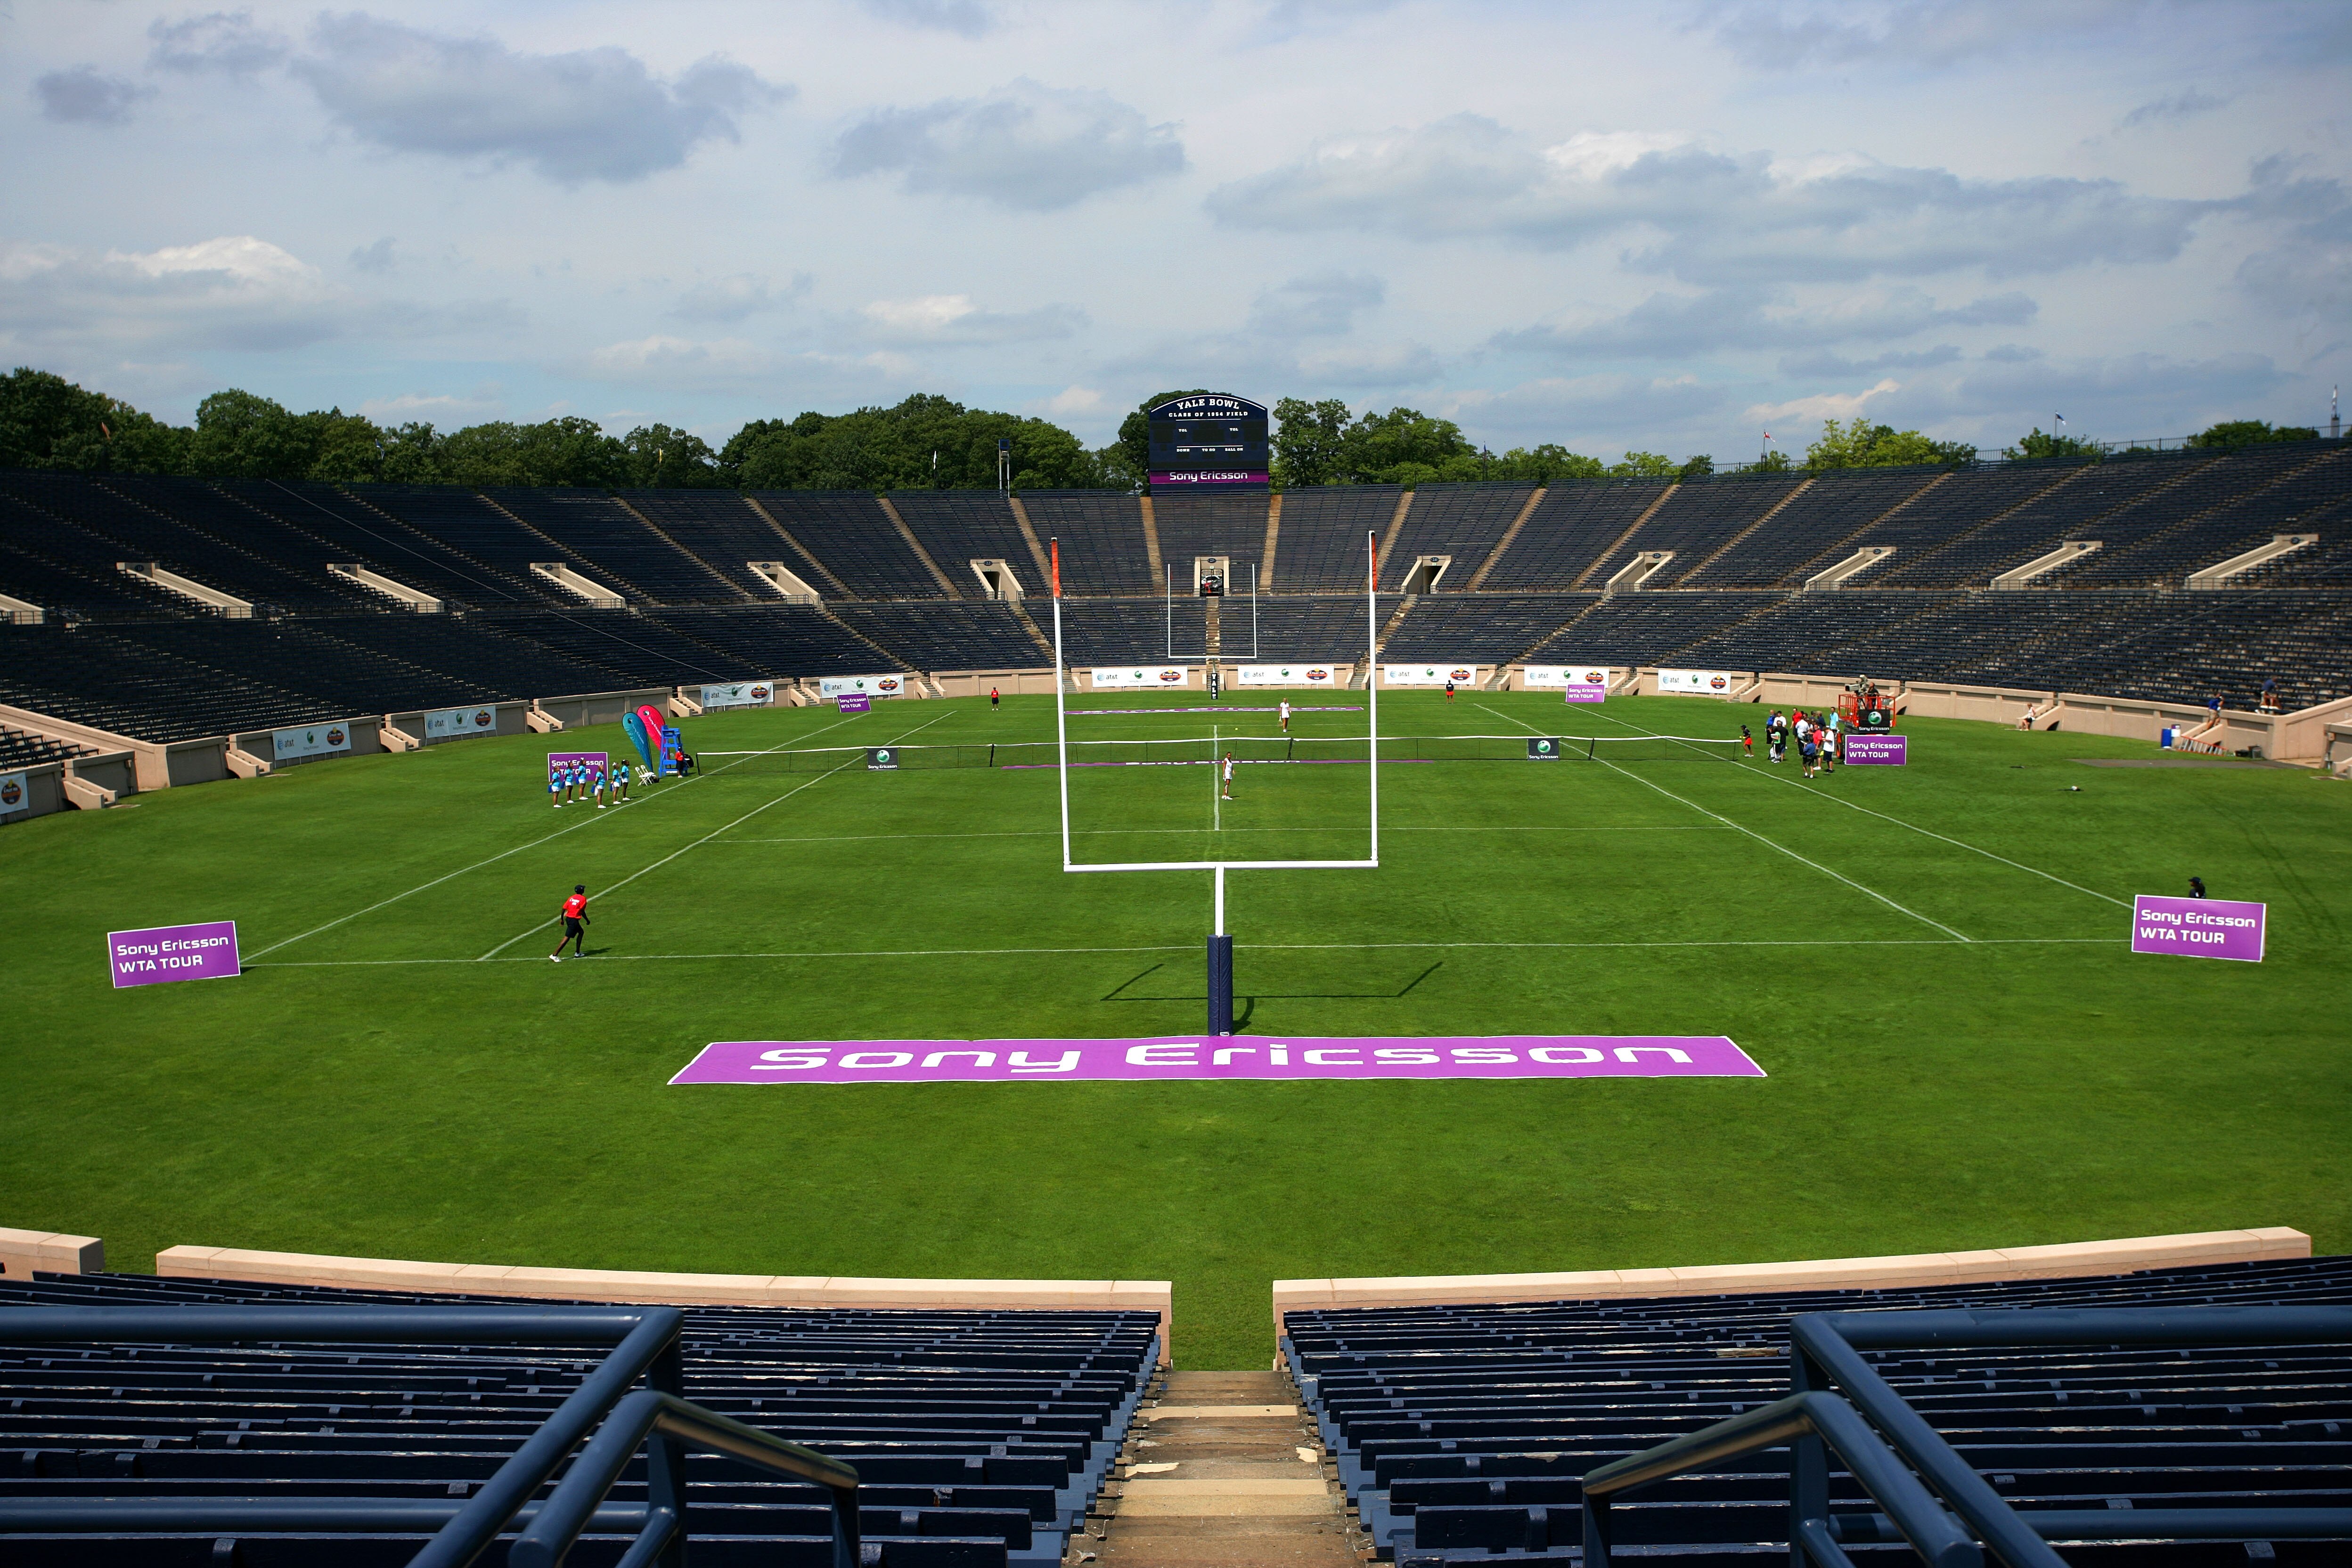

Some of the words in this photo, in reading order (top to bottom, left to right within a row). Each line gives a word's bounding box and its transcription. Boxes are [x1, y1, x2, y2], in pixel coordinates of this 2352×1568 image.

[1176, 399, 1205, 410] YALE
[1209, 399, 1239, 409] BOWL
[1169, 472, 1197, 482] Sony
[1200, 472, 1248, 480] Ericsson
[284, 738, 294, 748] at&t
[2141, 909, 2181, 925] Sony
[2185, 912, 2255, 928] Ericsson
[2140, 927, 2177, 940] WTA
[2180, 930, 2225, 944] TOUR
[117, 944, 158, 956] Sony
[162, 937, 229, 951] Ericsson
[119, 960, 156, 973] WTA
[159, 955, 203, 970] TOUR
[750, 1047, 1080, 1073] Sony
[1125, 1043, 1693, 1066] Ericsson
